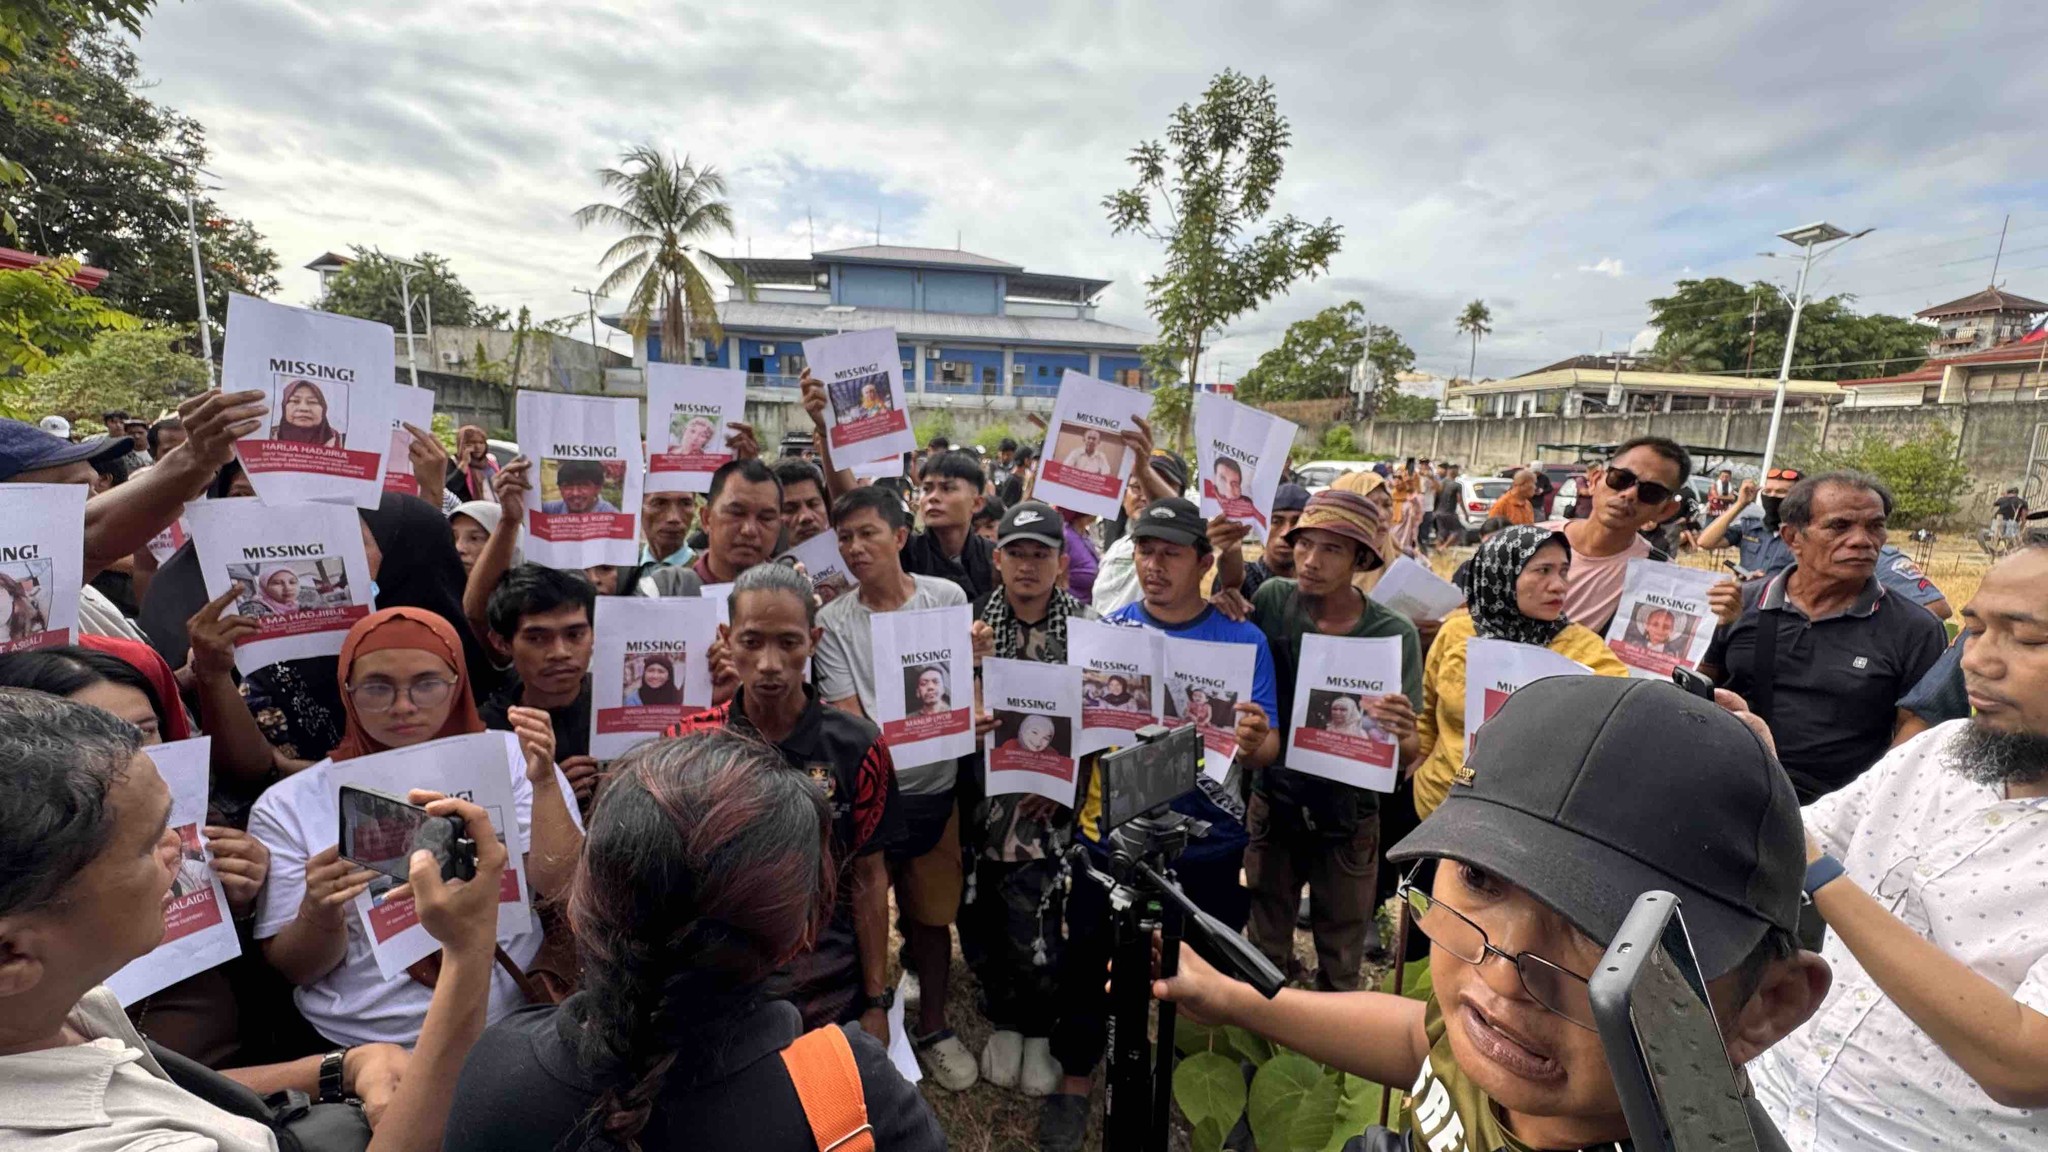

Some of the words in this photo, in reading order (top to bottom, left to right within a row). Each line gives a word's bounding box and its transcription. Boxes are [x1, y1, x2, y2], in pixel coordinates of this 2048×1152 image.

[269, 358, 355, 382] MISSING!
[834, 363, 879, 379] MISSING!
[674, 403, 722, 415] MISSING!
[1076, 412, 1121, 430] MISSING!
[553, 443, 618, 459] MISSING!
[1213, 439, 1259, 467] MISSING!
[243, 543, 325, 560] MISSING!
[1645, 593, 1697, 613] MISSING!
[626, 641, 686, 652] MISSING!
[901, 649, 952, 665] MISSING!
[1090, 659, 1139, 673] MISSING!
[1174, 671, 1226, 689] MISSING!
[1326, 676, 1384, 692] MISSING!
[1006, 697, 1057, 711] MISSING!
